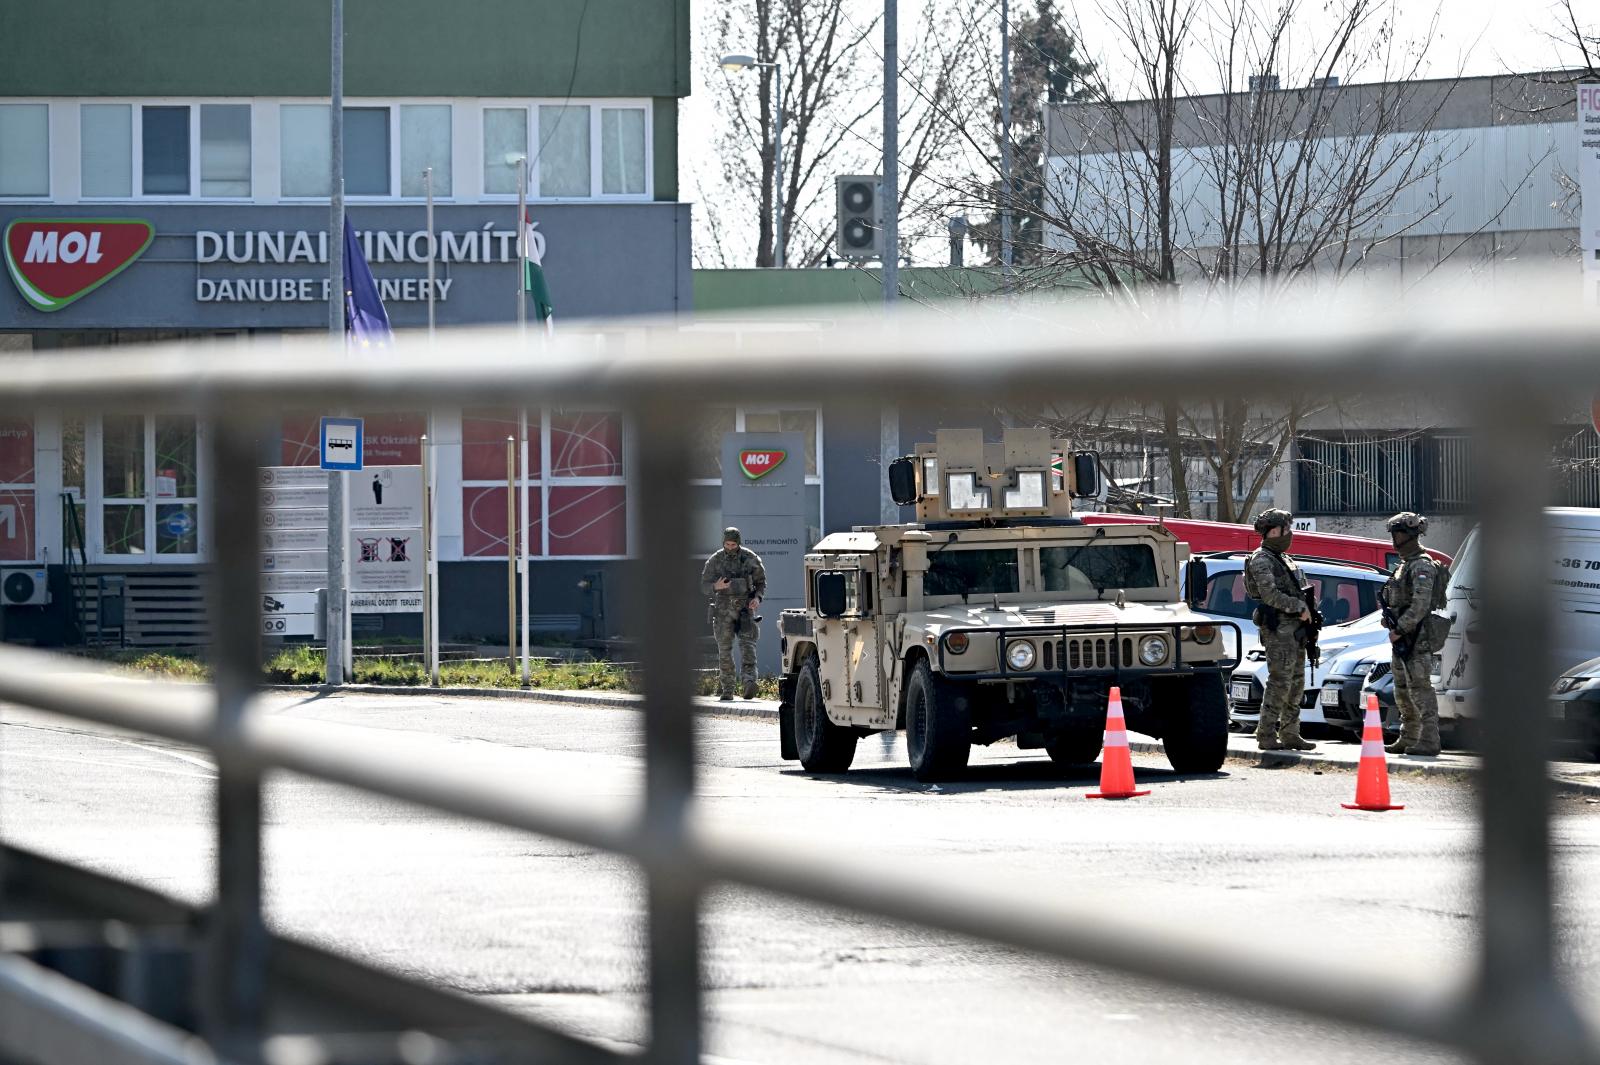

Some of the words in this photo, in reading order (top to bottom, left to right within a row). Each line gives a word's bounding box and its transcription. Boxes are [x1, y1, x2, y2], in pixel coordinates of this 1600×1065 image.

[23, 231, 103, 264] MOL
[196, 230, 328, 264] DUNAI
[196, 278, 313, 302] DANUBE
[746, 454, 770, 465] MOL
